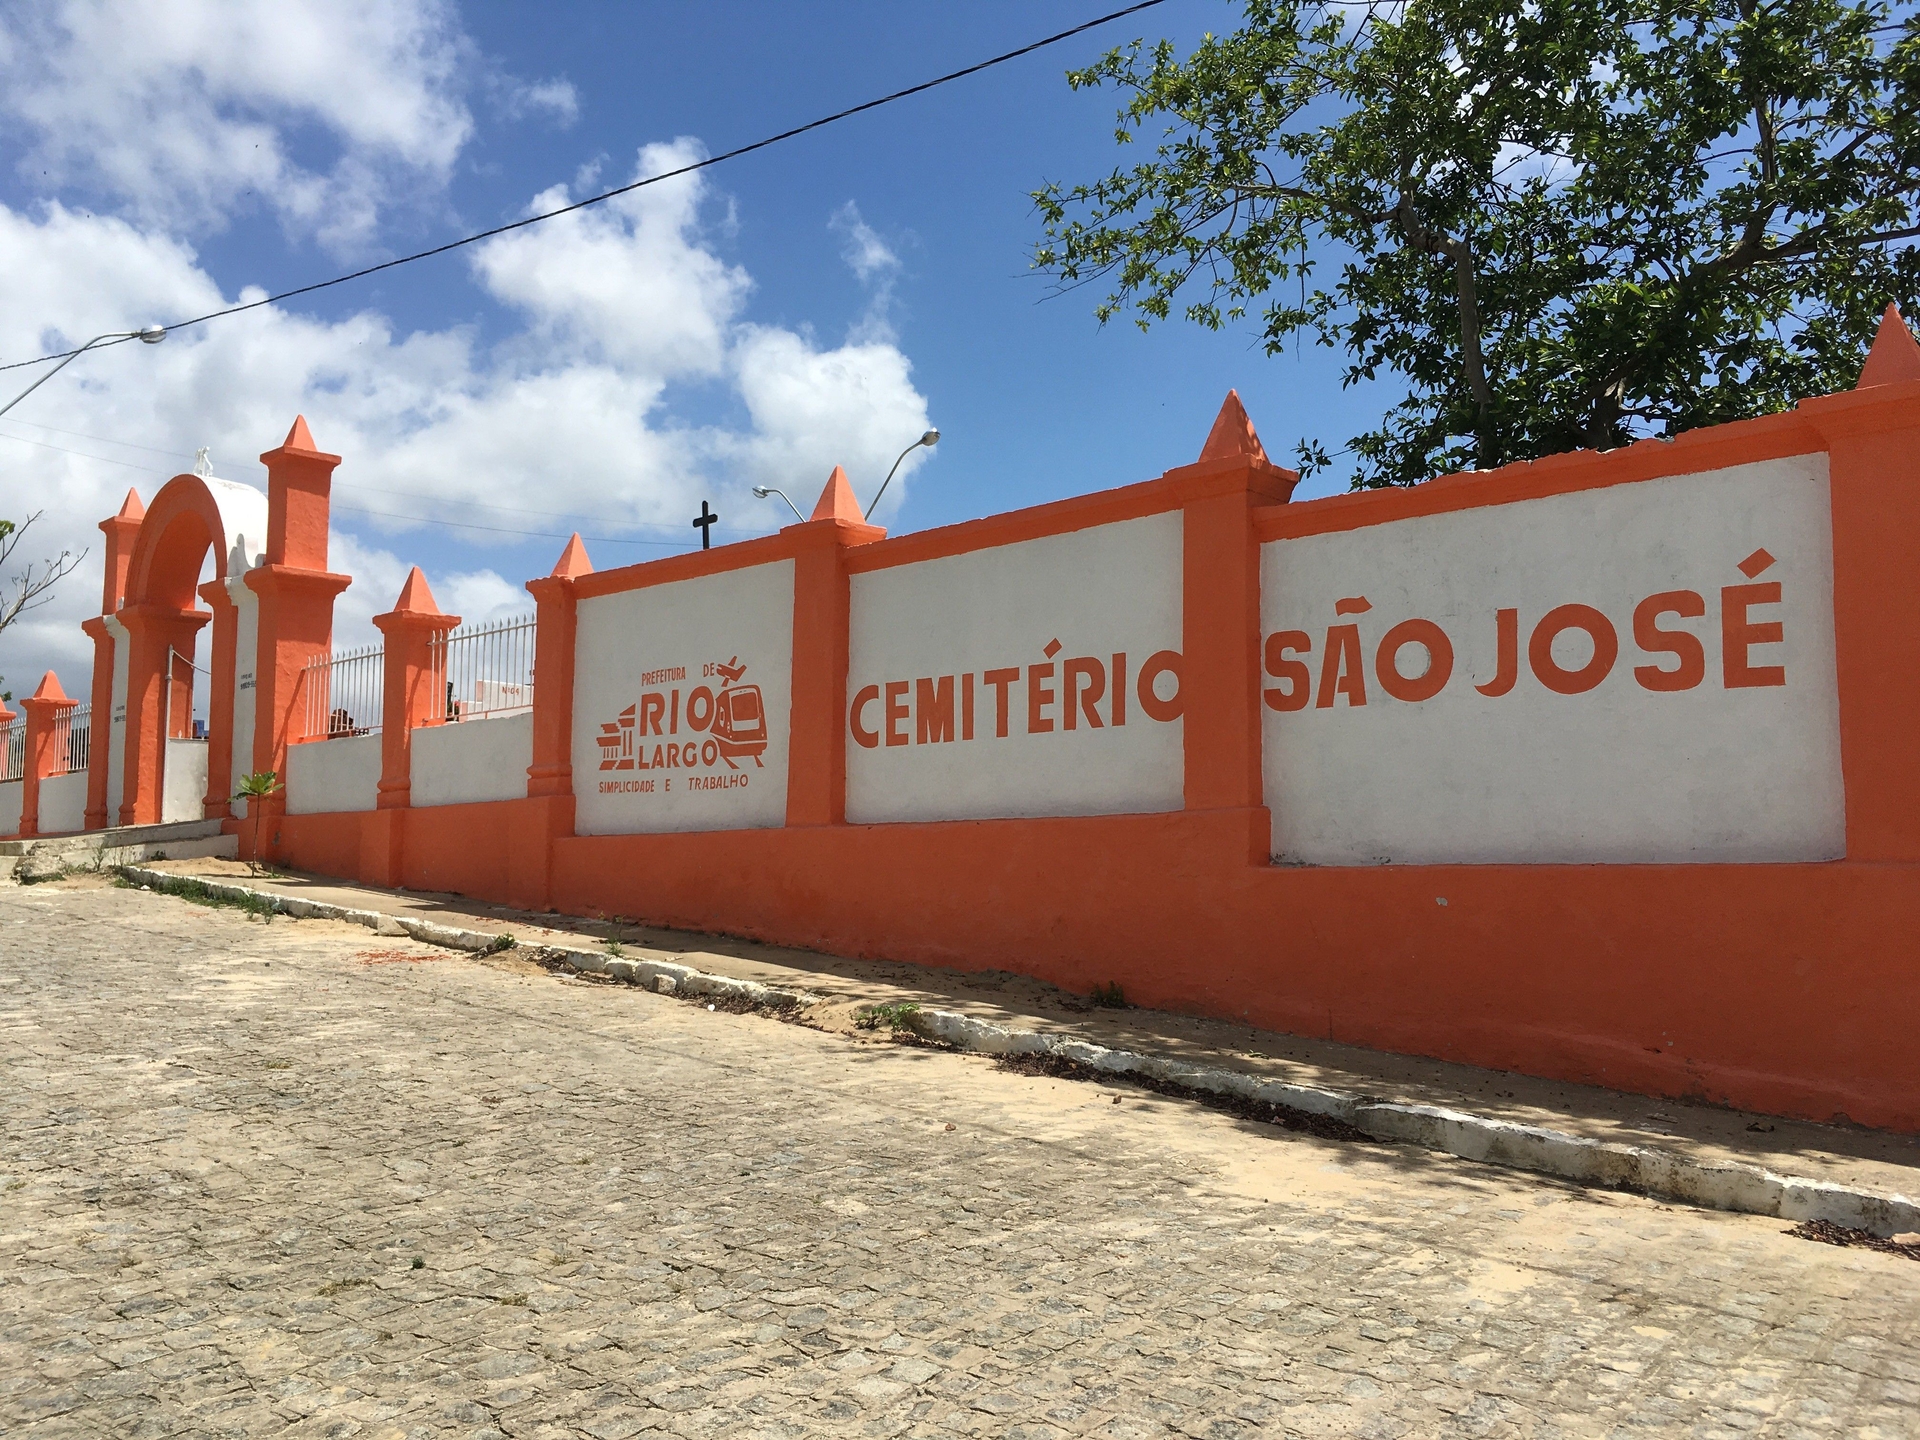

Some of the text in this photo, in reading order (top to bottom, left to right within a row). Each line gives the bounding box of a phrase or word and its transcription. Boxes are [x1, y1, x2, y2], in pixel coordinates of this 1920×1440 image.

[850, 547, 1787, 749] CEMITÉRIO SÃO JOSÉ
[641, 662, 715, 687] PREFEITURA DE
[639, 685, 715, 737] RIO
[638, 739, 718, 770] LARGO
[599, 773, 749, 794] SIMPLICIDADE E TRABALHO
